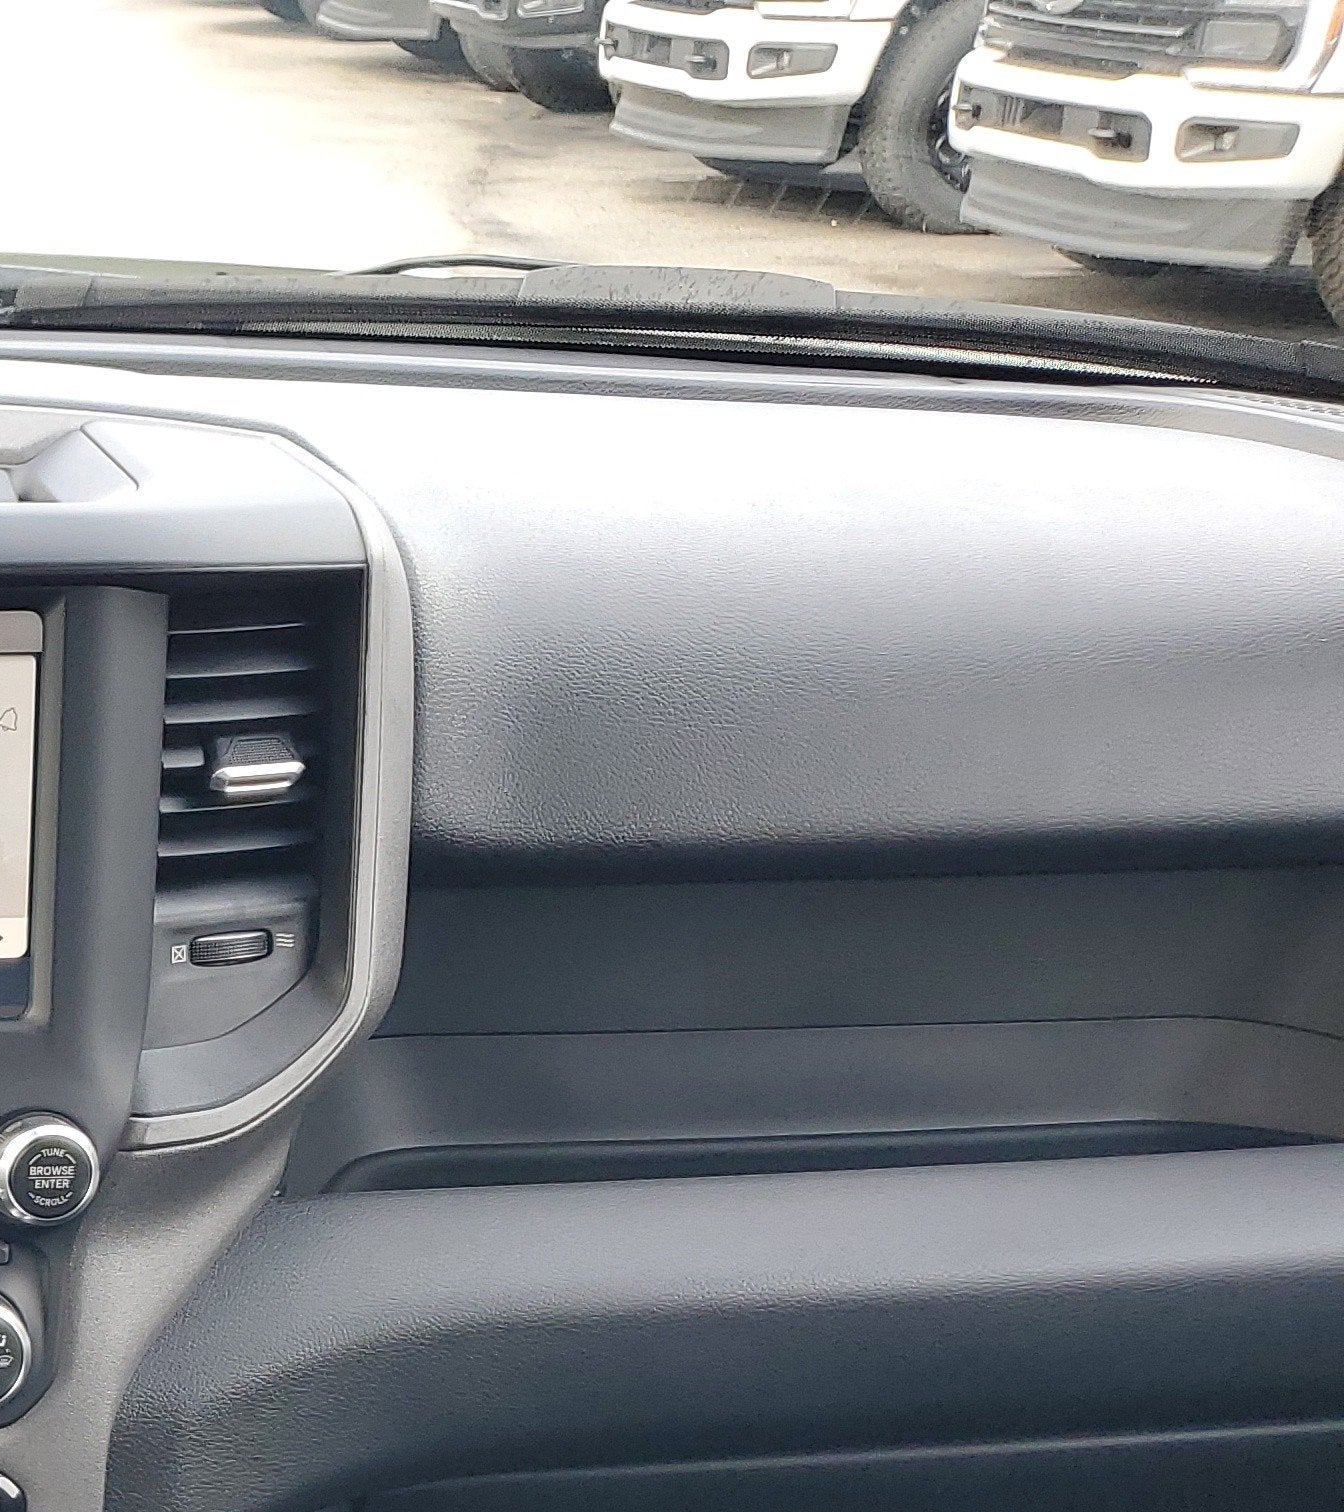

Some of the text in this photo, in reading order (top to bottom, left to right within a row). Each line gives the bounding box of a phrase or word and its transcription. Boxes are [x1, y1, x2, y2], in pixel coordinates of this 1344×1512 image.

[41, 1147, 66, 1158] TUNE
[29, 1165, 76, 1176] BROWSE
[34, 1179, 70, 1189] ENTER
[33, 1195, 69, 1207] SCROLL
